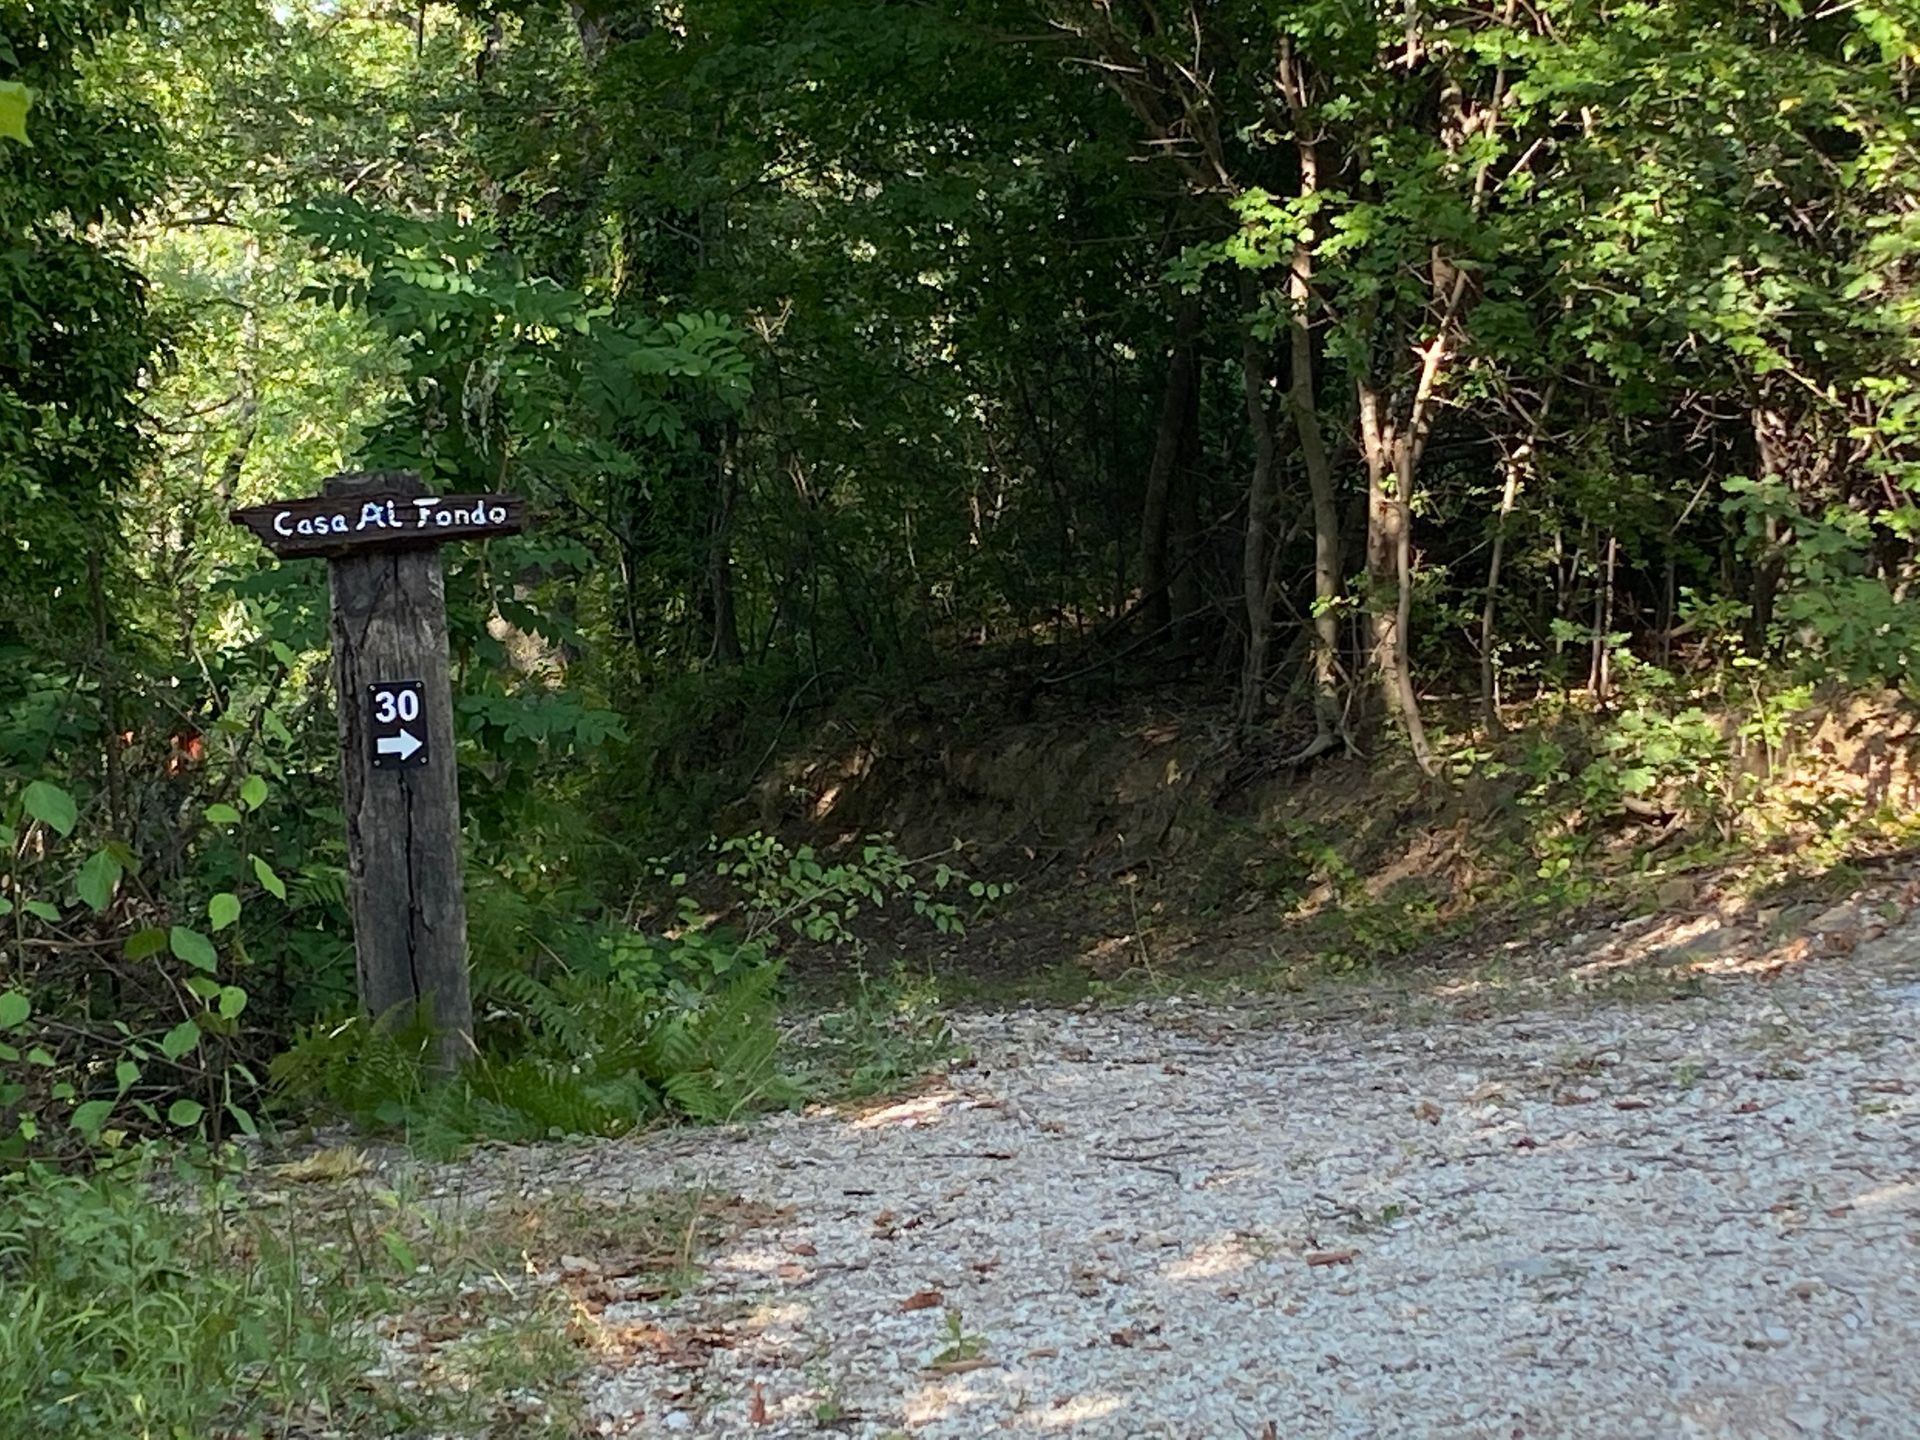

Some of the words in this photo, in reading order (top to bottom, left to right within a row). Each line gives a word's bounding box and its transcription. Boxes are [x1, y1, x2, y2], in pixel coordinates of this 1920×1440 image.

[273, 511, 349, 537] Casa
[355, 500, 403, 531] Al
[412, 497, 506, 528] Fondo
[375, 689, 419, 723] 30
